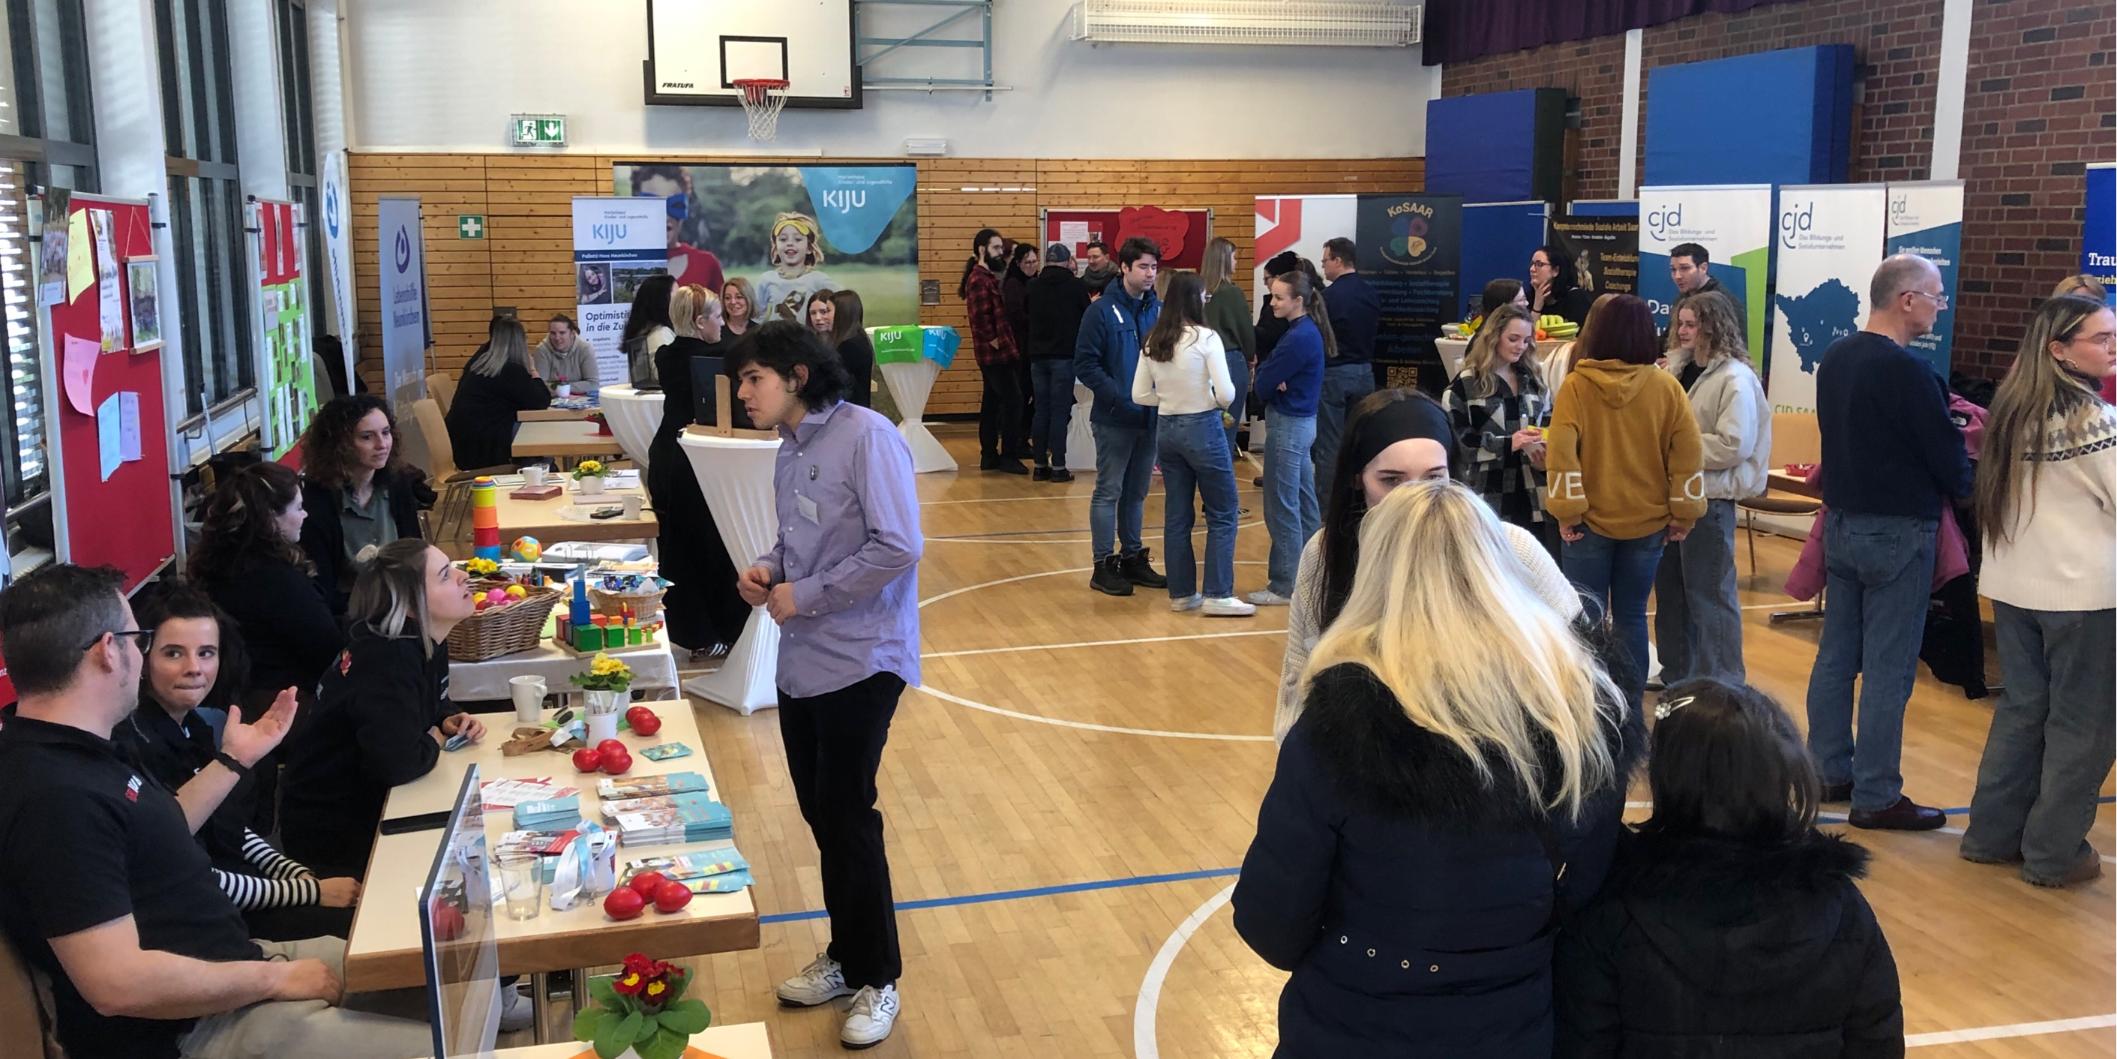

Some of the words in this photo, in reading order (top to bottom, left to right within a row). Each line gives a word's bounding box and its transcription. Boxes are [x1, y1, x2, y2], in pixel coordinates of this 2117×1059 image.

[823, 190, 866, 214] KIJU
[1387, 202, 1434, 219] KoSAAR
[1892, 193, 1907, 219] cjd
[1648, 203, 1682, 233] cjd
[1782, 201, 1813, 239] cjd
[592, 224, 627, 245] KIJU
[1648, 299, 1673, 315] Da
[586, 323, 594, 332] in
[597, 322, 610, 332] die
[880, 330, 902, 344] KIJU
